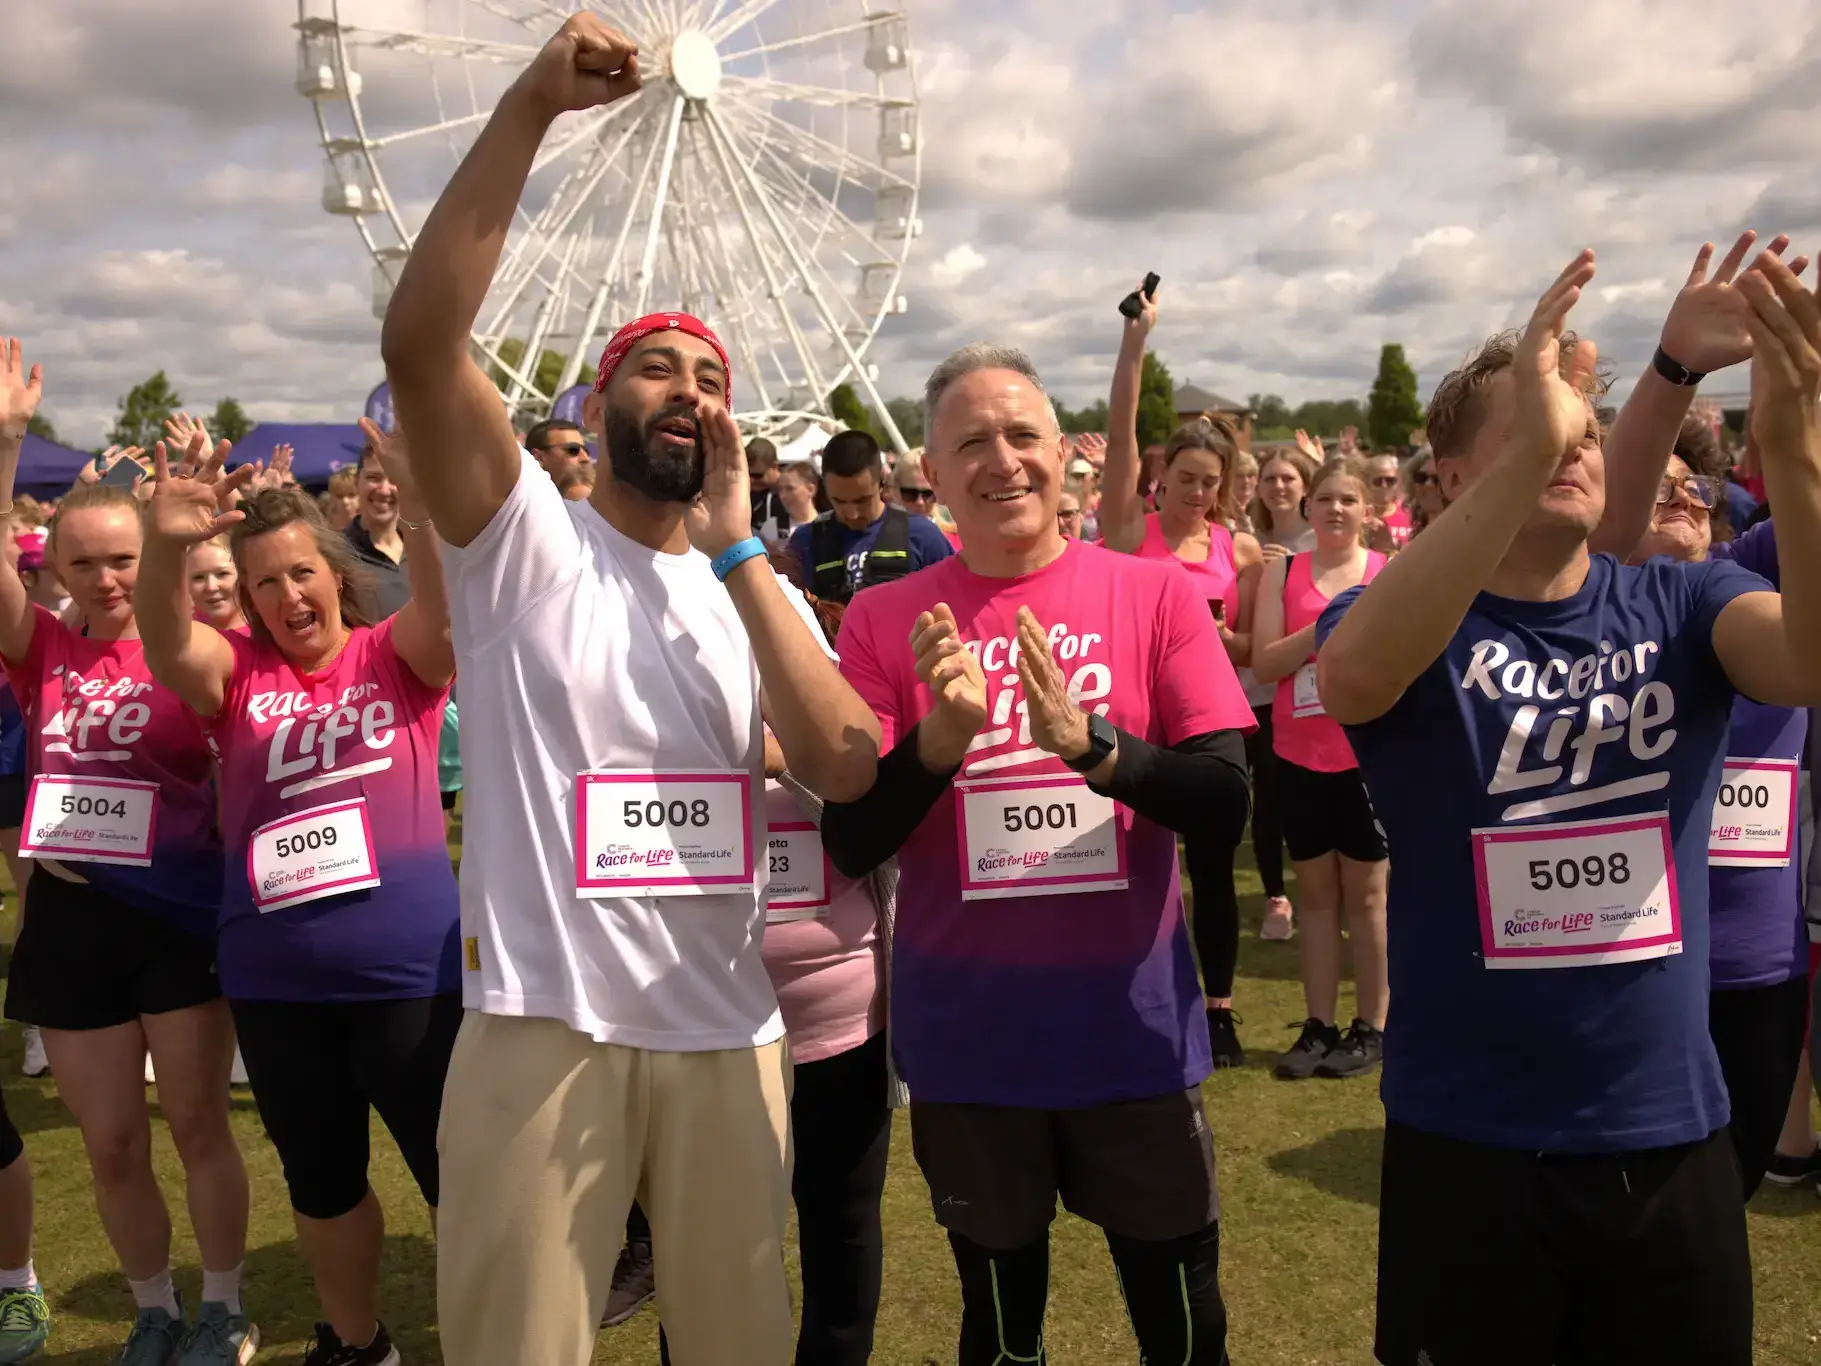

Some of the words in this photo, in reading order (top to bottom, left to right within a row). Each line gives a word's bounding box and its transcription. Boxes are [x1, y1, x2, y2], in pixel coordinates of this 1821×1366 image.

[1048, 623, 1102, 660] for
[1461, 638, 1597, 700] Race
[1594, 639, 1659, 690] for
[104, 676, 153, 698] for
[338, 682, 379, 706] for
[265, 700, 396, 783] Life
[1487, 681, 1678, 795] Life
[60, 795, 127, 818] 5004
[1718, 783, 1769, 808] 000
[623, 799, 710, 828] 5008
[1003, 802, 1077, 832] 5001
[36, 828, 61, 839] Race
[73, 828, 96, 839] Life
[275, 826, 338, 858] 5009
[1718, 825, 1742, 838] Life
[1745, 828, 1771, 836] Standard
[1771, 828, 1781, 836] Life
[679, 850, 715, 859] Standard
[716, 849, 732, 858] Life
[768, 839, 788, 848] eta
[1054, 848, 1090, 860] Standard
[1090, 847, 1105, 857] Life
[318, 859, 346, 872] Standard
[346, 857, 359, 866] Life
[596, 853, 628, 869] Race
[629, 852, 646, 863] for
[646, 849, 674, 864] Life
[769, 856, 790, 873] 23
[977, 856, 1006, 872] Race
[1007, 855, 1023, 866] for
[1022, 851, 1049, 866] Life
[263, 876, 284, 891] Race
[285, 873, 296, 883] for
[296, 866, 315, 880] Life
[1528, 852, 1631, 891] 5098
[1504, 920, 1540, 937] Race
[1541, 918, 1561, 931] for
[1561, 913, 1594, 930] Life
[1600, 908, 1641, 922] Standard
[1642, 906, 1658, 917] Life
